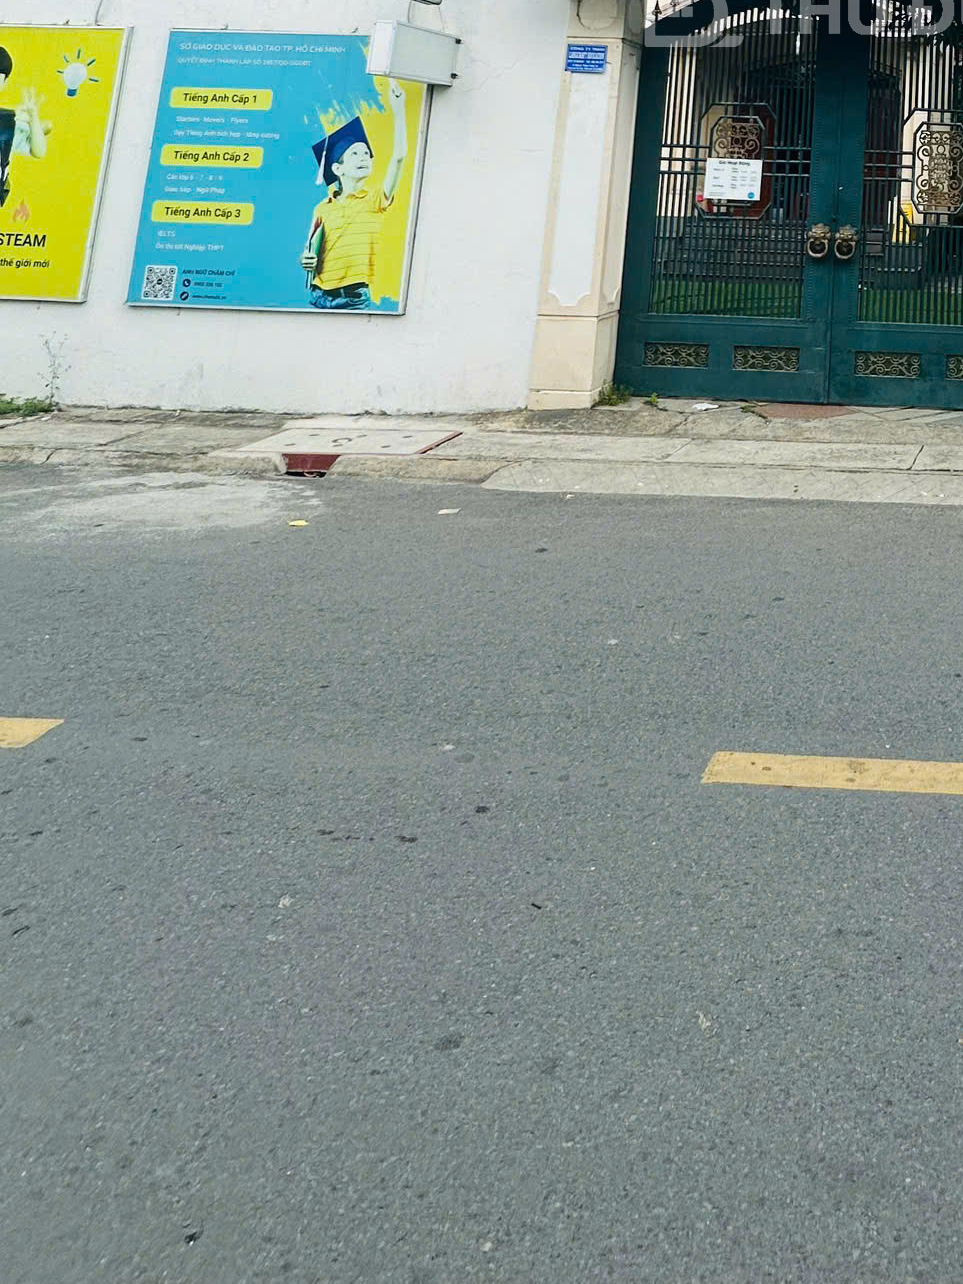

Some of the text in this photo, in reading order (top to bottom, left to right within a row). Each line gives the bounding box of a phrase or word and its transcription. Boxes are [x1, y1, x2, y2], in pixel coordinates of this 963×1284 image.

[183, 92, 257, 105] Tiếng Anh Cấp 1
[174, 150, 249, 163] Tiếng Anh Cấp 2
[165, 206, 241, 219] Tiếng Anh Cấp 3
[0, 257, 50, 268] thế giới mới
